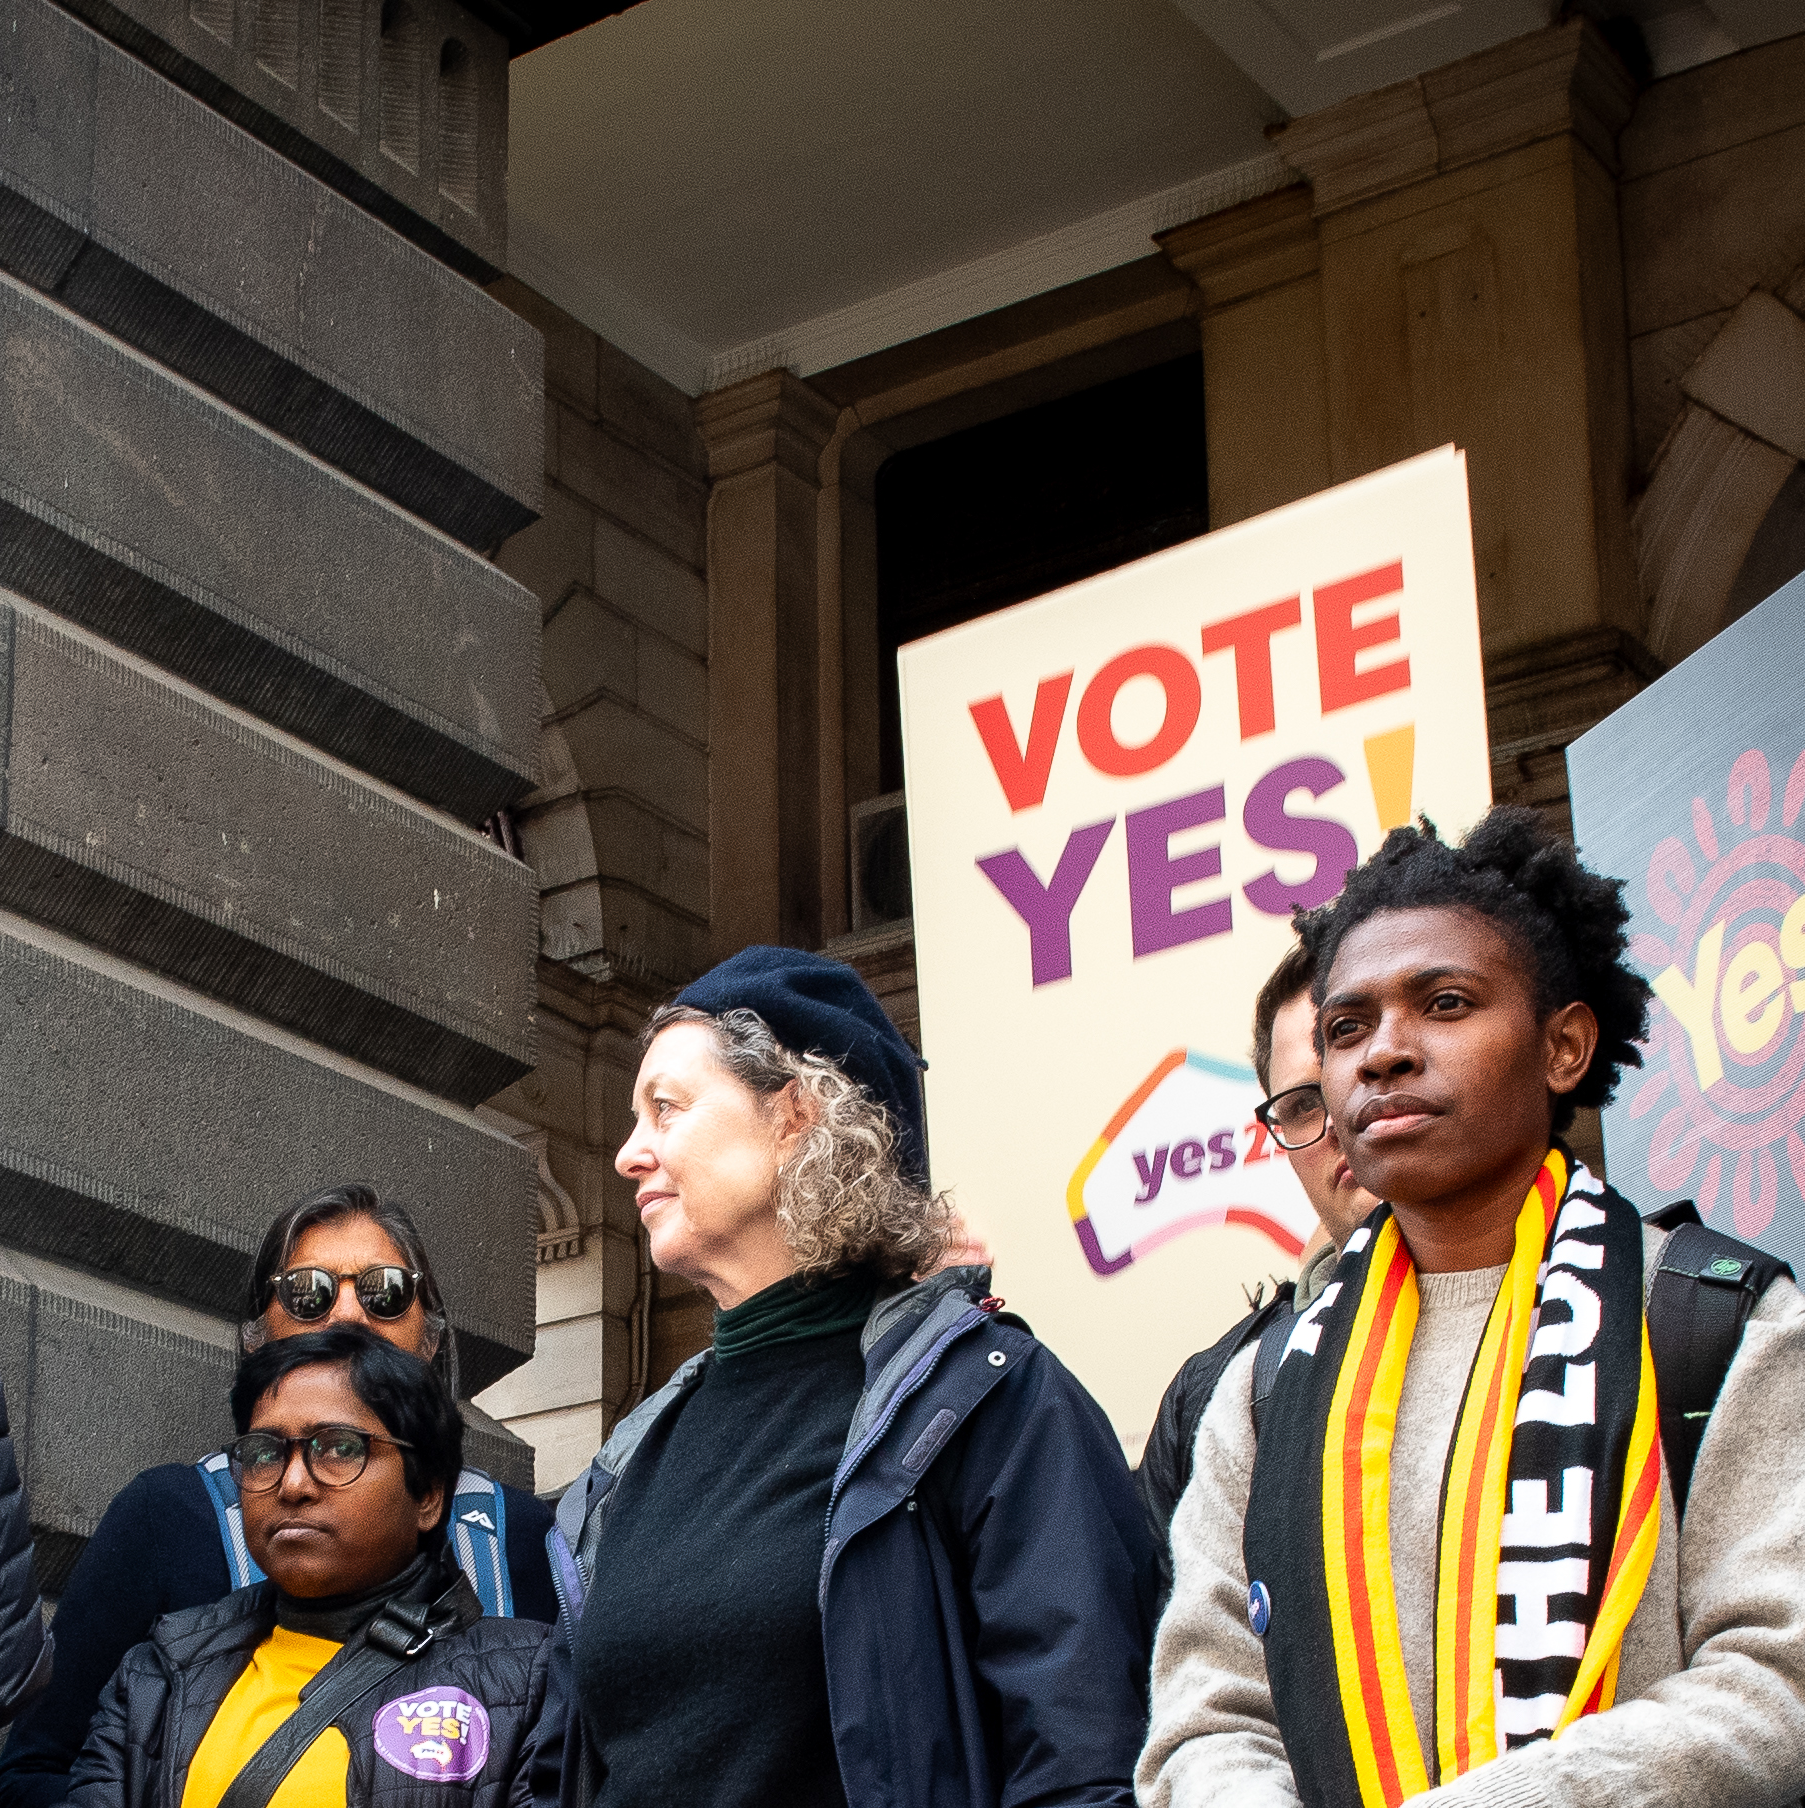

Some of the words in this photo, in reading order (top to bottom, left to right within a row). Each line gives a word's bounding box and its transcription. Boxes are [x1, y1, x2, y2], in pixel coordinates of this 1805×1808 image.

[967, 555, 1413, 815] VOTE
[974, 722, 1417, 992] YES!
[1515, 1159, 1606, 1426] LON
[396, 1715, 471, 1746] YES!
[397, 1700, 472, 1722] VOTE
